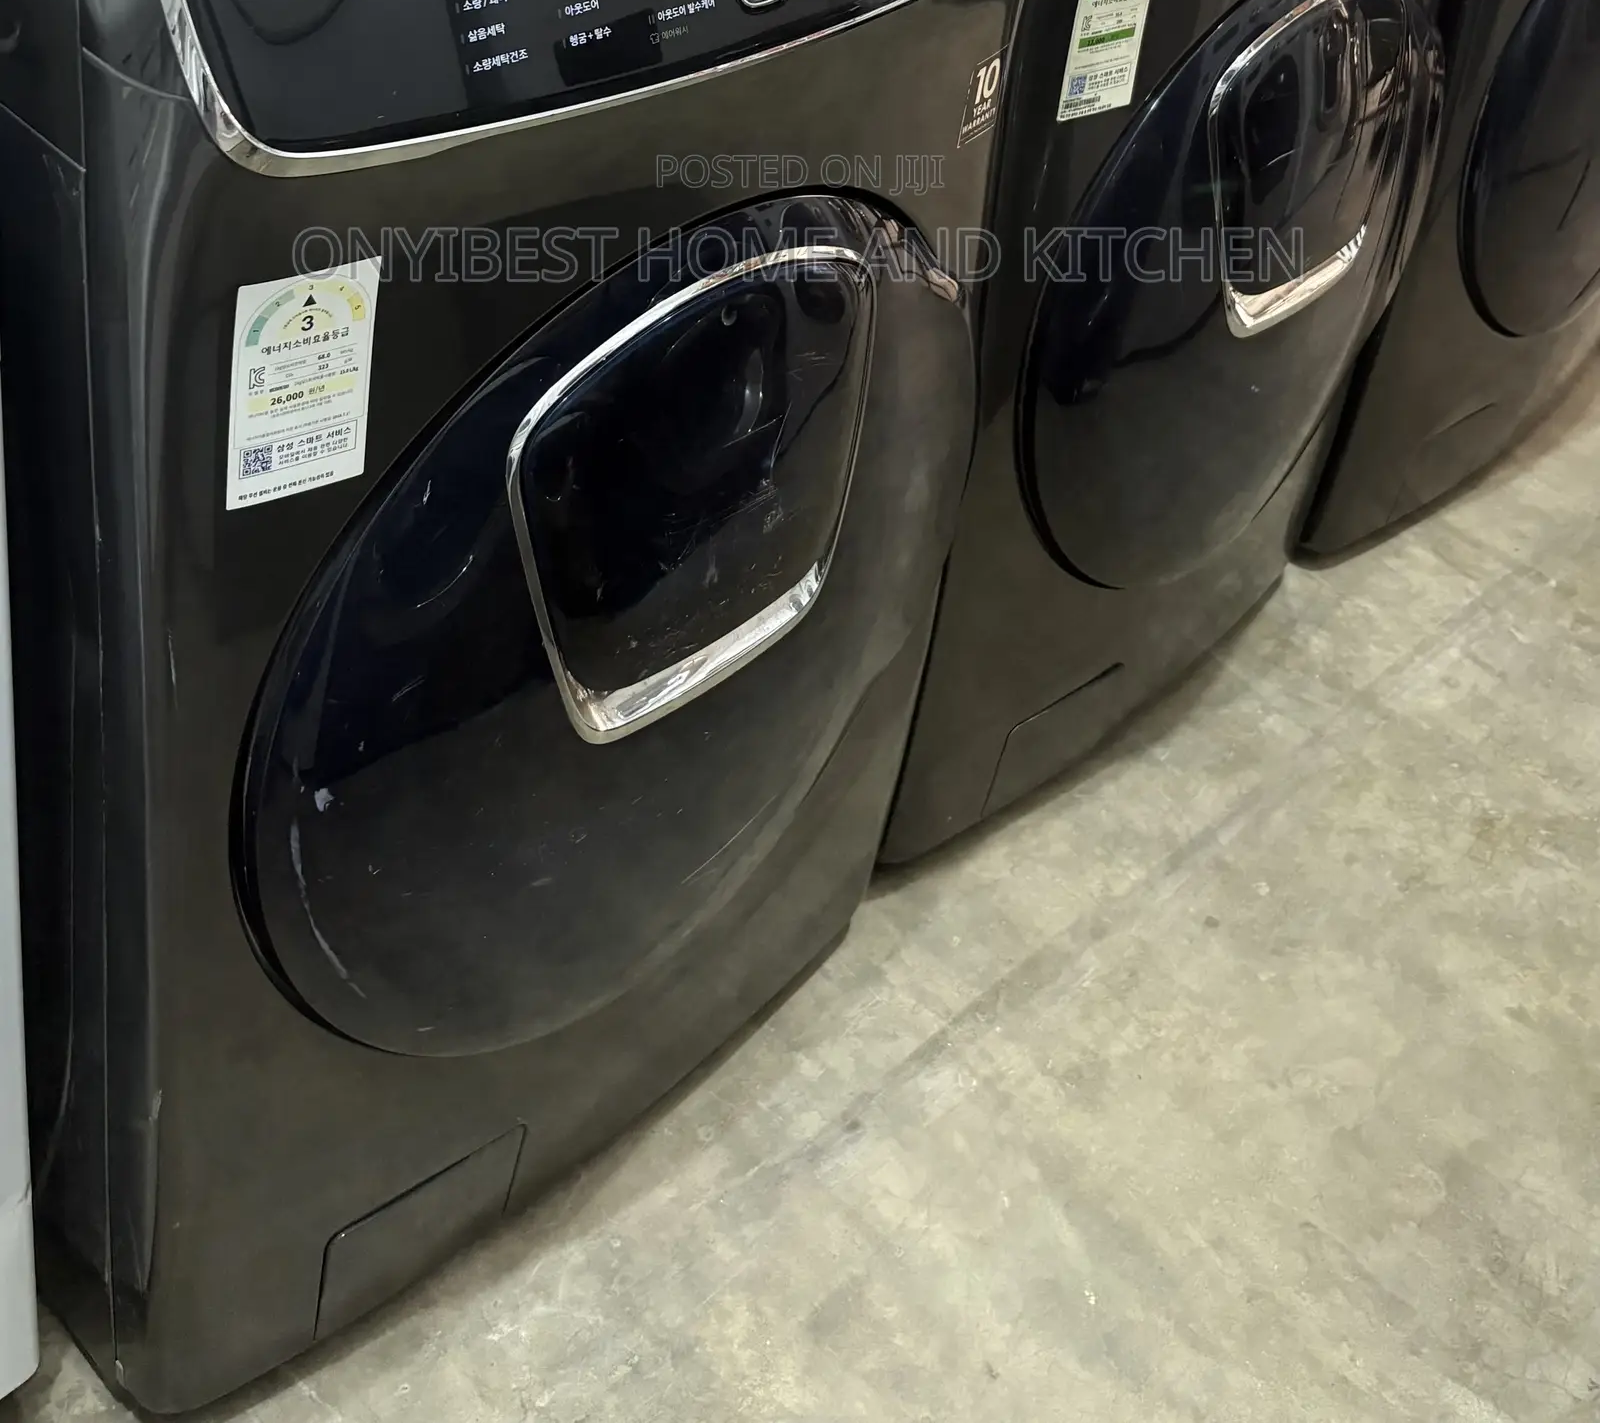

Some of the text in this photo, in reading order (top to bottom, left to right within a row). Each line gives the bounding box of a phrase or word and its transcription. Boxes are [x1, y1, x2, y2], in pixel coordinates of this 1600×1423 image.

[657, 5, 687, 22] 아웃도어
[468, 22, 506, 43] 삶음세탁
[473, 48, 529, 73] 소량세탁건조
[975, 58, 1000, 105] 10
[973, 98, 992, 118] YEAR
[301, 315, 315, 332] 3
[261, 326, 350, 356] 에너지소비효율등급
[270, 390, 304, 406] 26,000
[277, 426, 351, 453] 삼성 스마트 서비스
